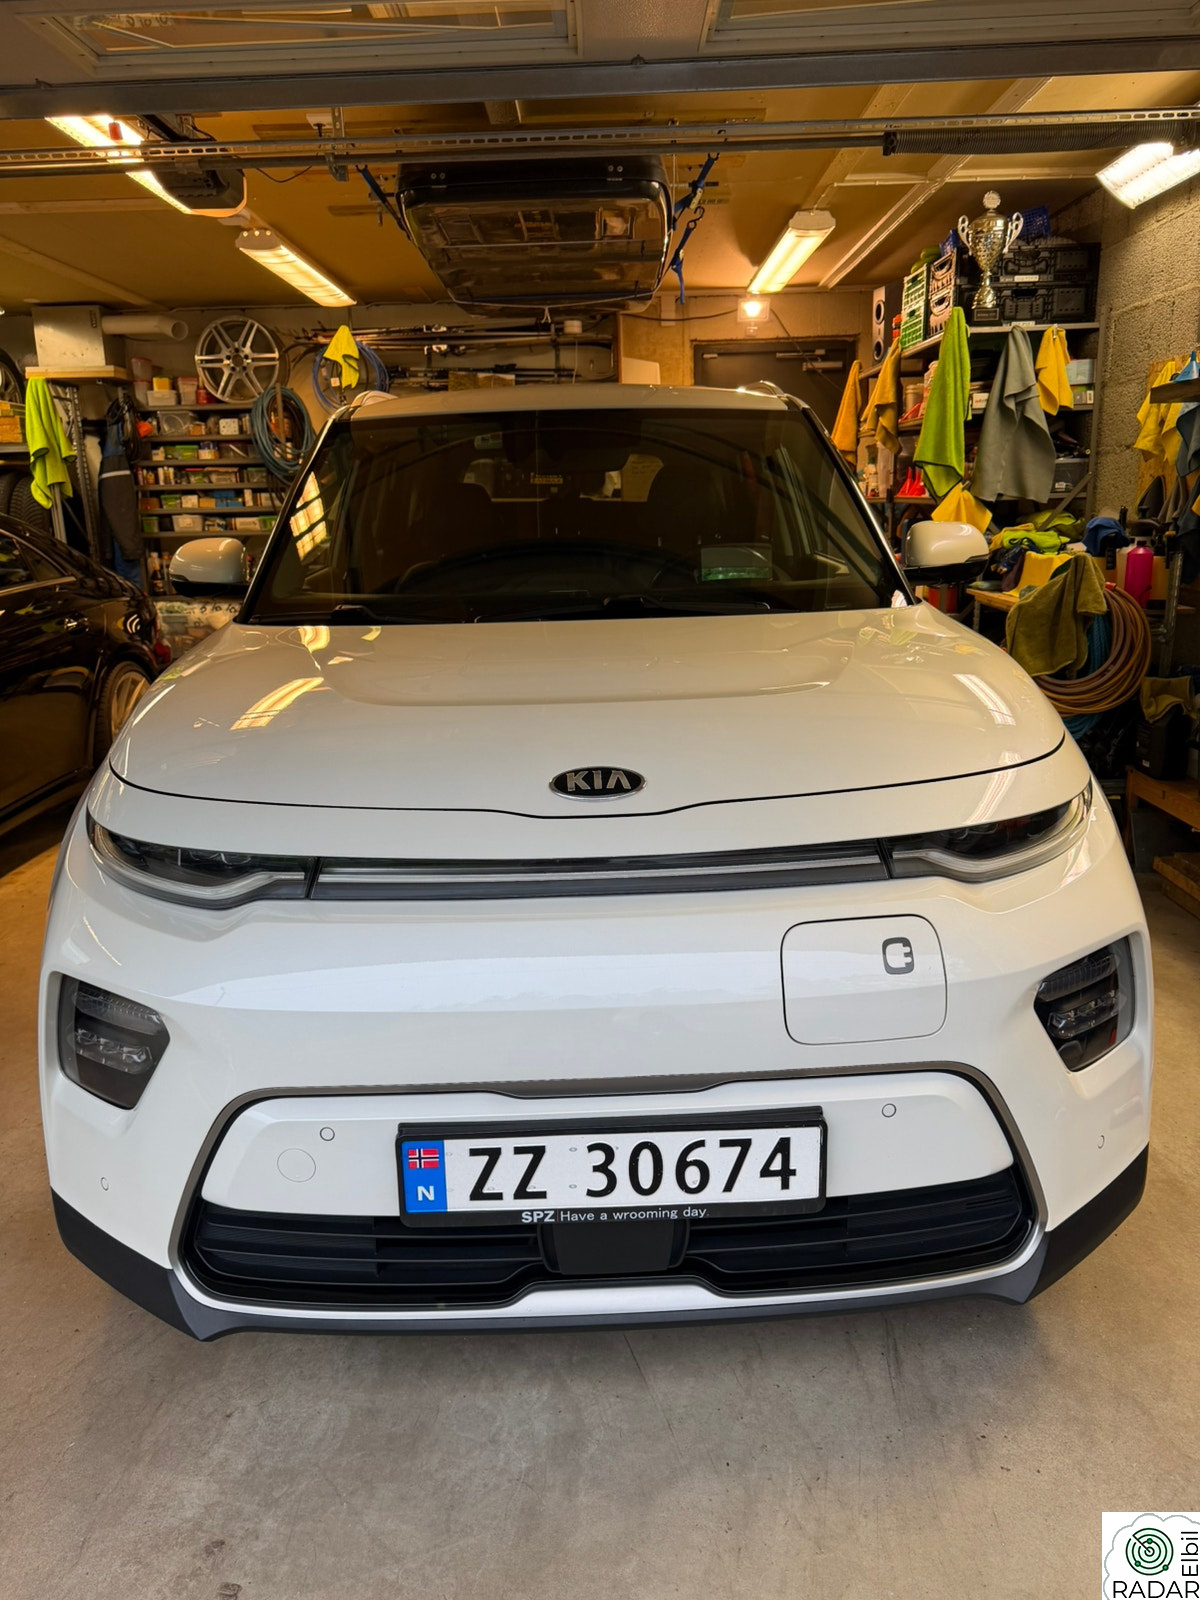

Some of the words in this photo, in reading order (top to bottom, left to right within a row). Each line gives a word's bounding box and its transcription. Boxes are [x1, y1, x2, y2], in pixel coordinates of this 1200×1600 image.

[566, 769, 632, 792] KIA
[469, 1145, 548, 1201] ZZ
[586, 1136, 797, 1198] 30674
[417, 1185, 435, 1201] N
[521, 1210, 555, 1223] SPZ
[560, 1211, 595, 1222] Have
[600, 1212, 608, 1221] a
[612, 1207, 678, 1220] wrooming
[683, 1206, 710, 1218] day.
